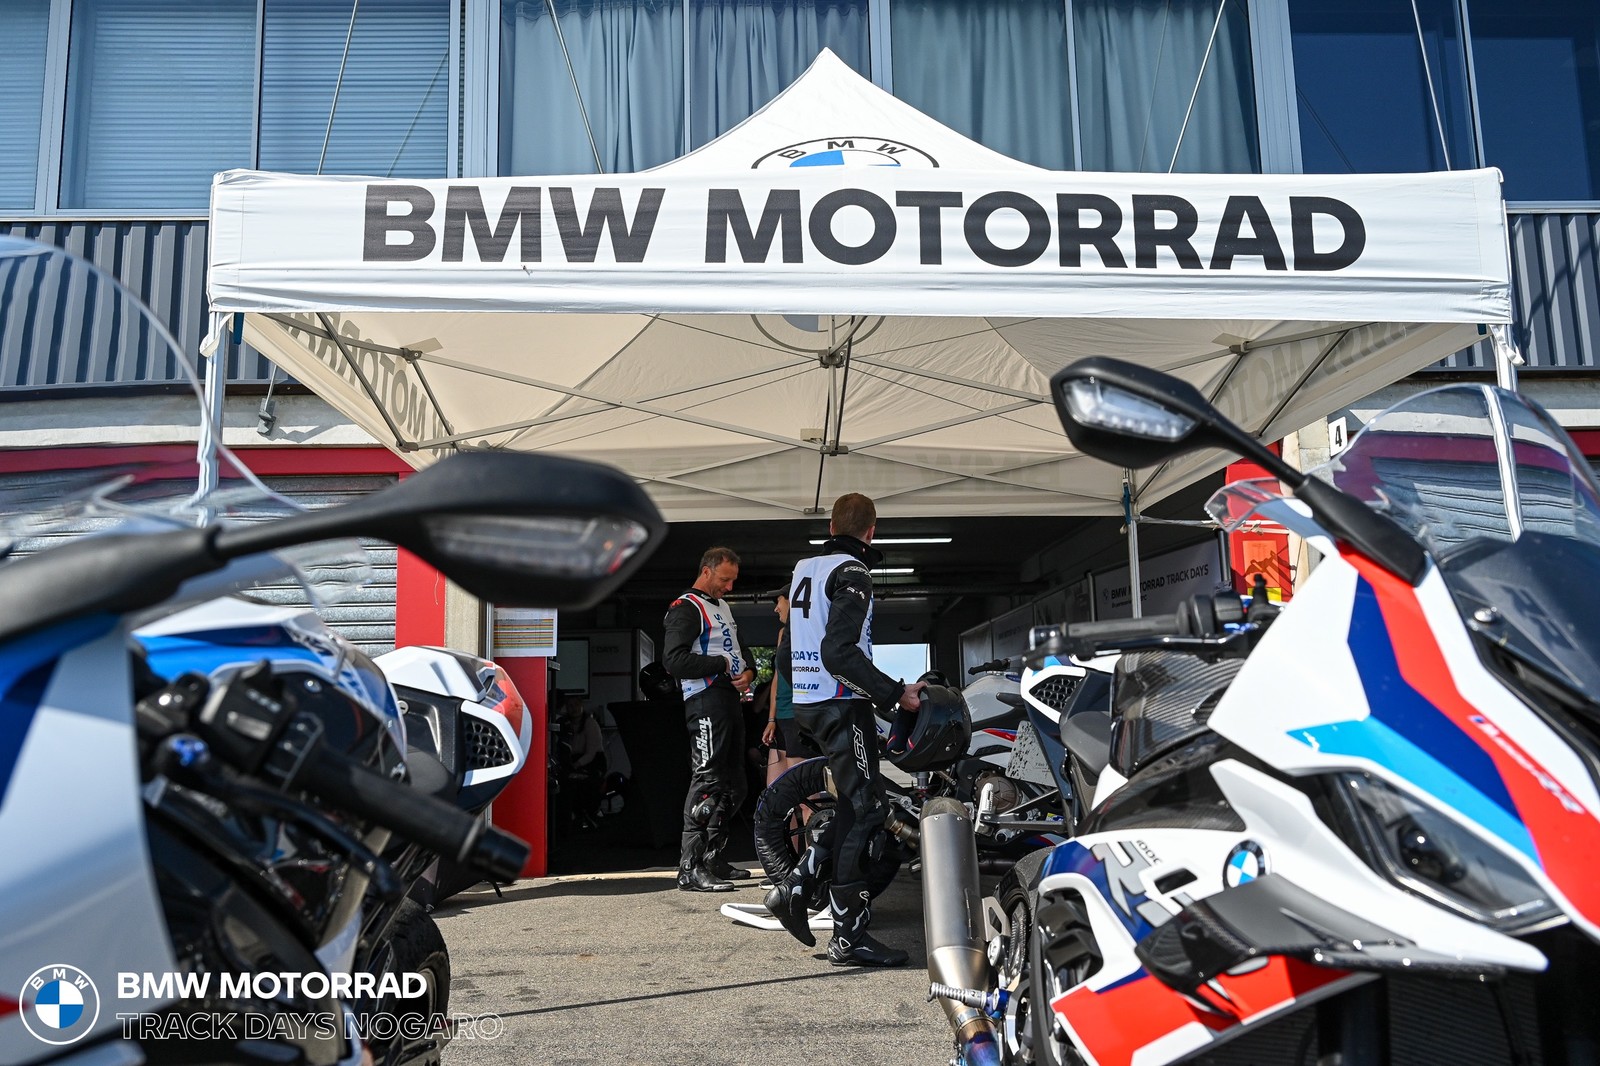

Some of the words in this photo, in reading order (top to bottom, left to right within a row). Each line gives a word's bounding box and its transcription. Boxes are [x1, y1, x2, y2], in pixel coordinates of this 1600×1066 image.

[778, 140, 907, 160] BMW
[362, 184, 666, 263] BMW
[704, 187, 1366, 272] MOTORRAD
[1335, 425, 1342, 448] 4
[790, 576, 812, 619] 4
[1111, 586, 1127, 600] BMW
[1166, 570, 1190, 586] TRACK
[1190, 563, 1209, 579] DAYS
[852, 723, 870, 780] RST
